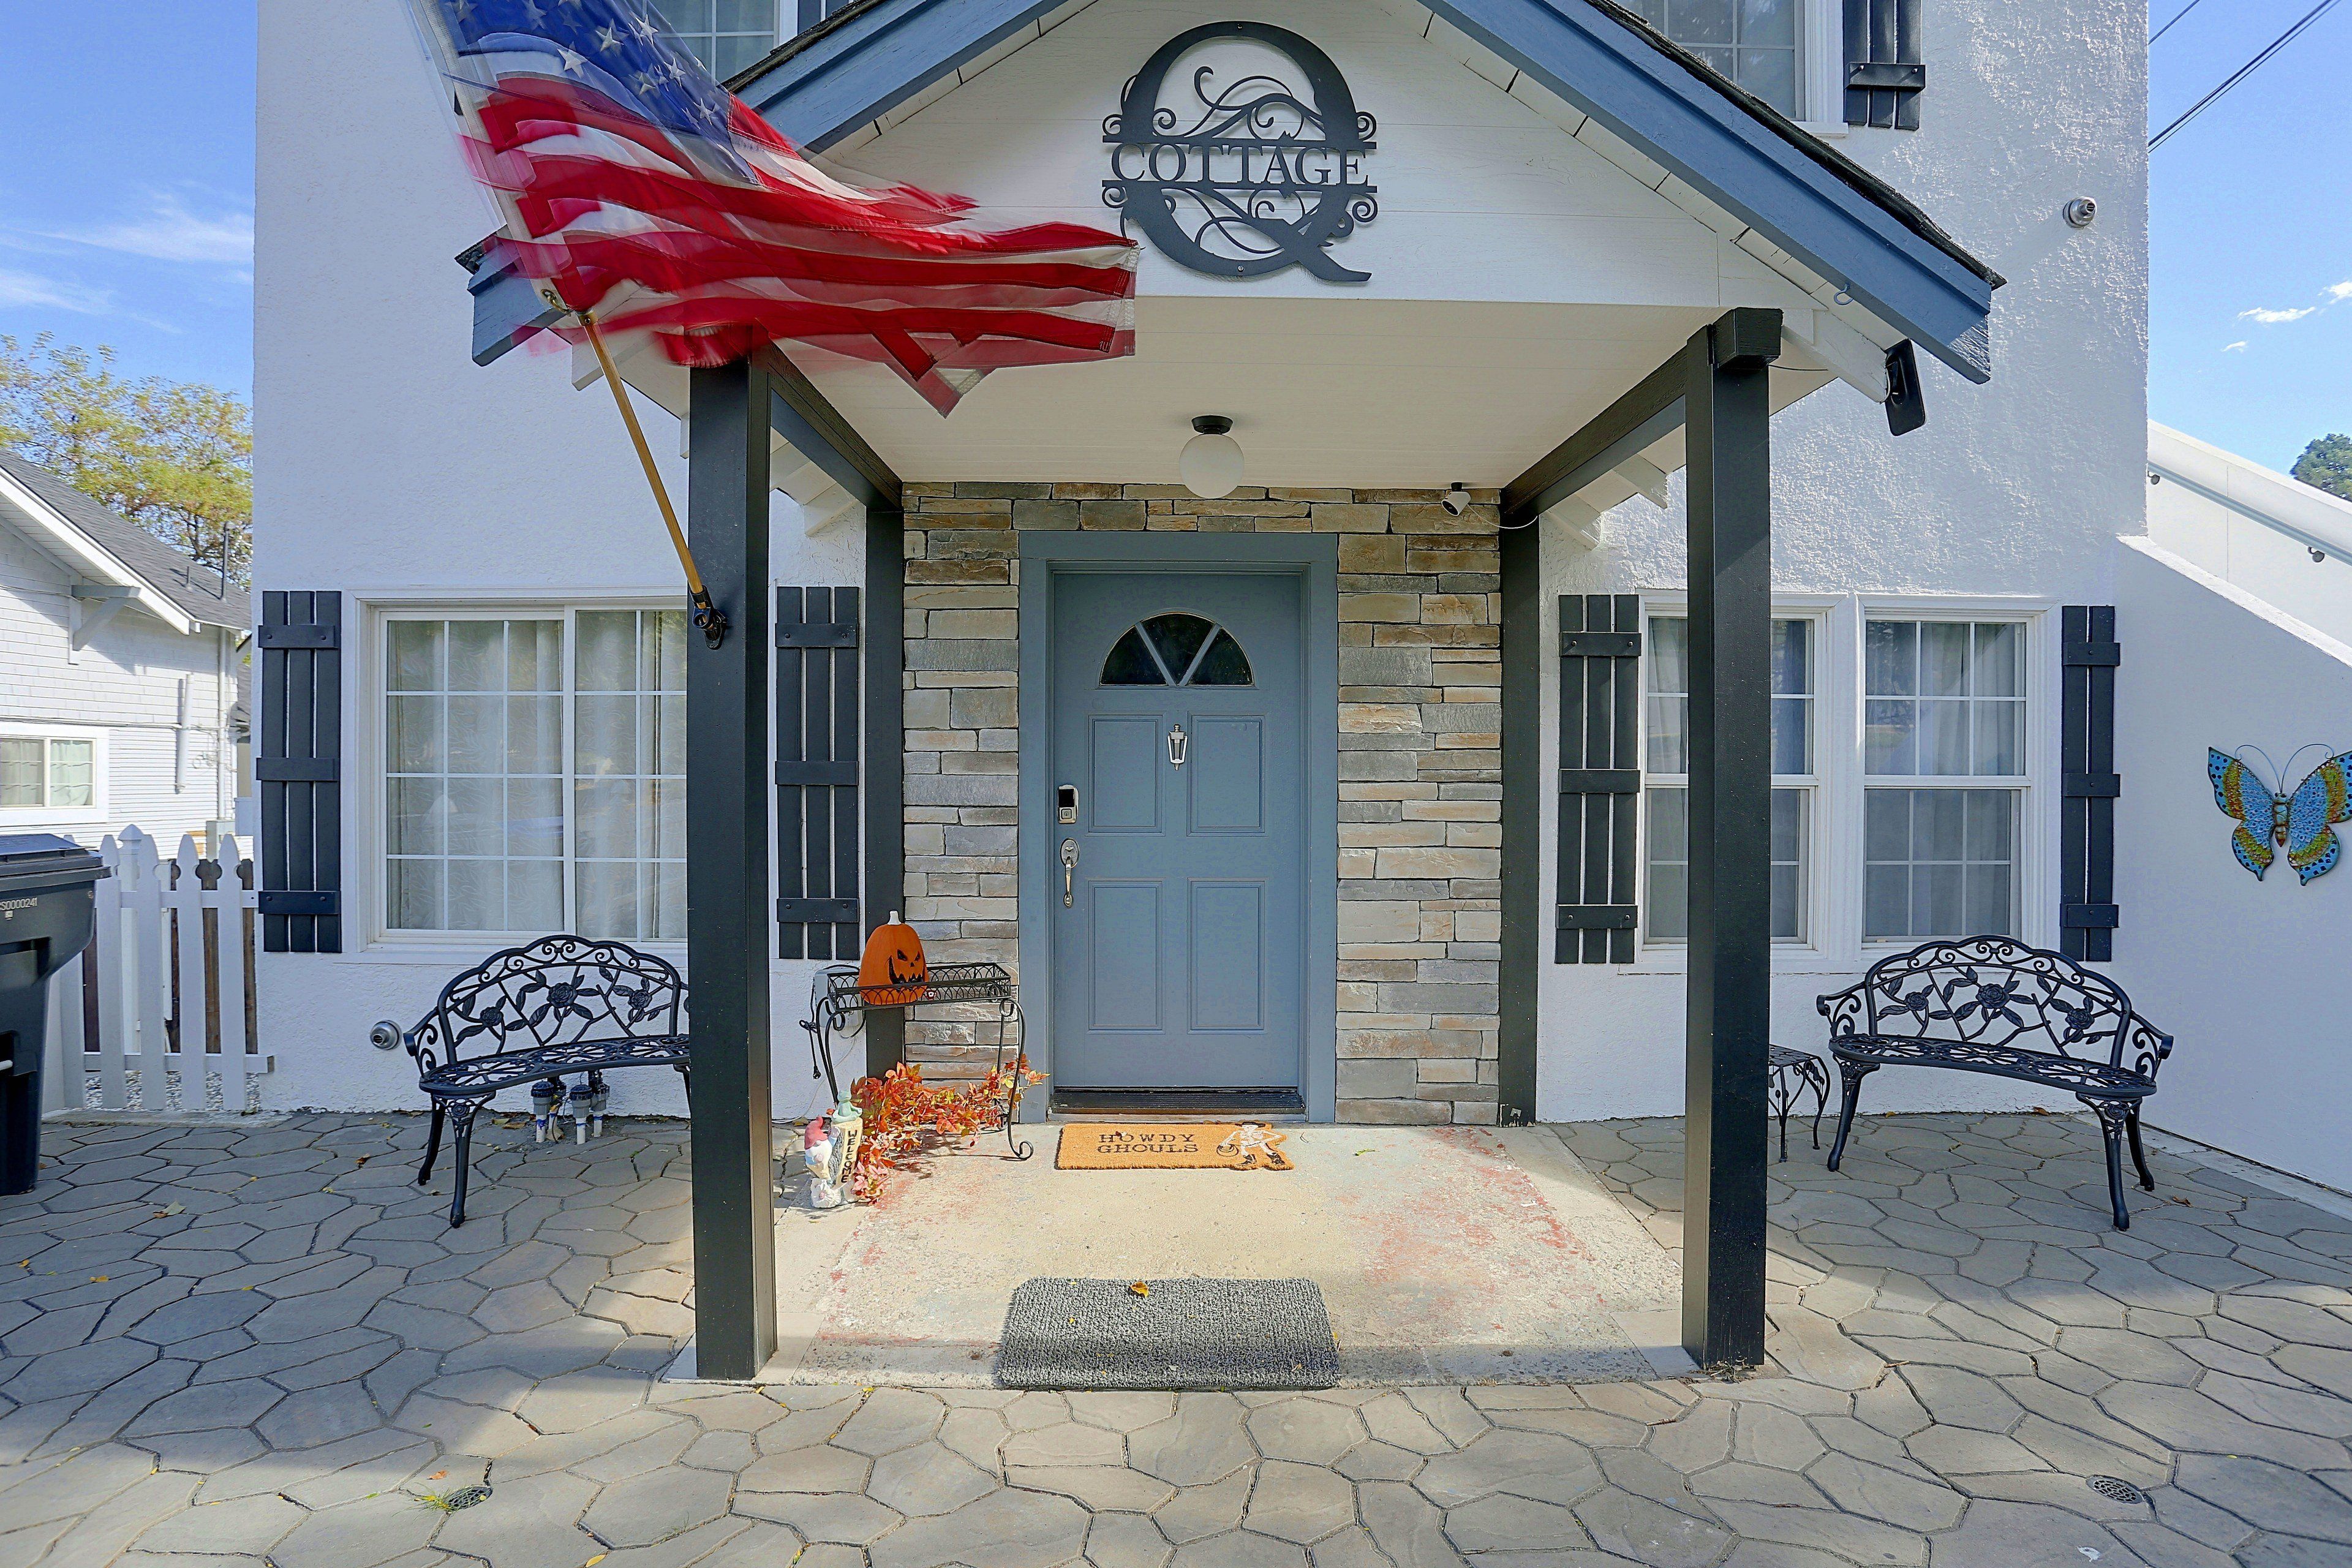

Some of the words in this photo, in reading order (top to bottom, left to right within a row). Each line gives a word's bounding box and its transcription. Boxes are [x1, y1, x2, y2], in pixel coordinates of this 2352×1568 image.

[1111, 143, 1370, 186] COTTAGE
[0, 897, 38, 911] S0000241
[1098, 1133, 1195, 1143] HOWDY
[1097, 1144, 1199, 1153] GHOULS
[840, 1129, 858, 1183] WELCOME
